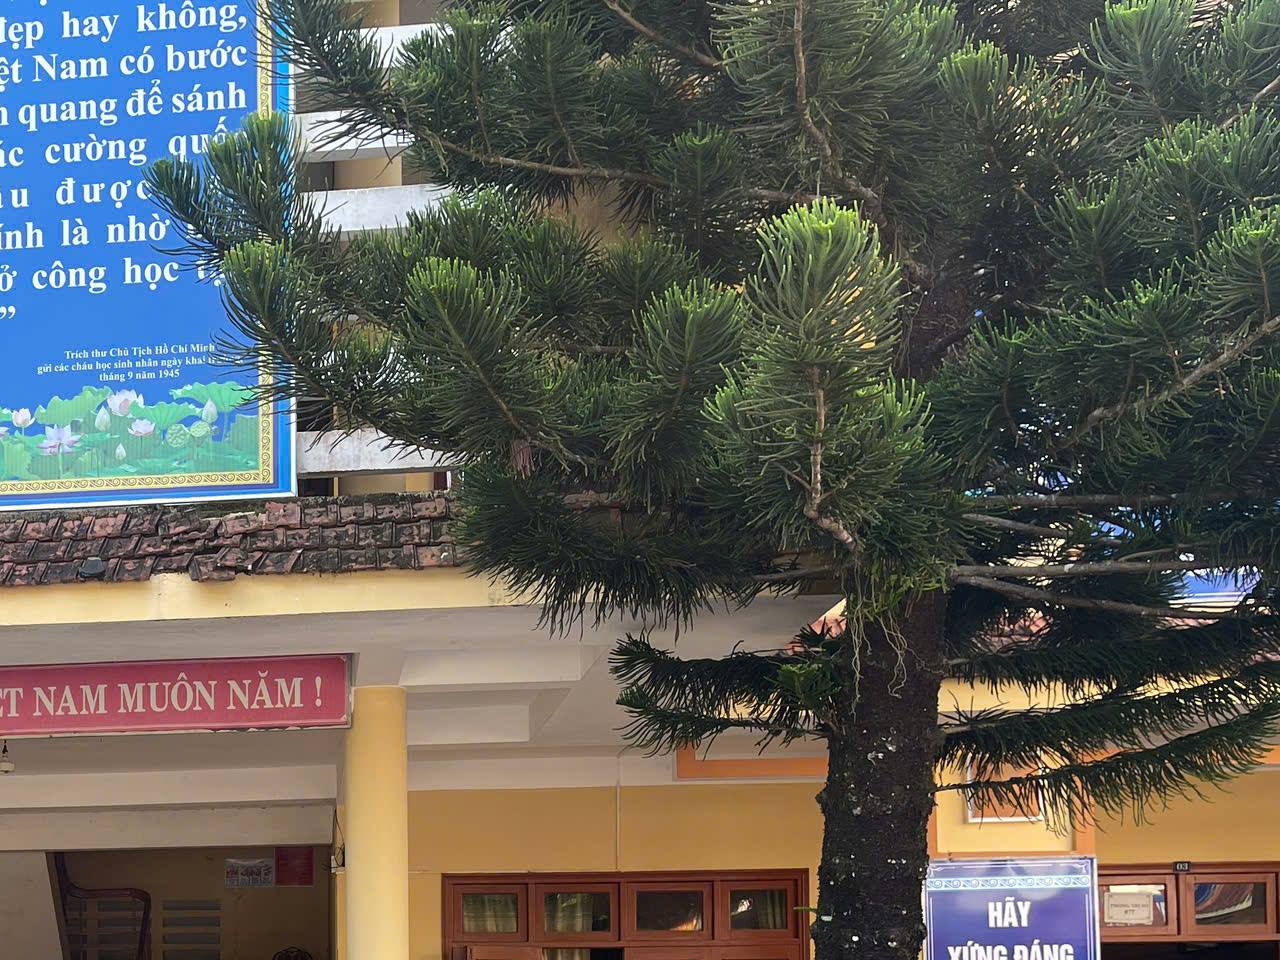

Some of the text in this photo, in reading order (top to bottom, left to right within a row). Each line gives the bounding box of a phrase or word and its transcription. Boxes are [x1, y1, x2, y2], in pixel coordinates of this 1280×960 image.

[62, 11, 119, 43] hay
[137, 0, 247, 33] không,
[32, 53, 108, 82] Nam
[119, 45, 155, 75] có
[166, 39, 247, 72] bước
[18, 98, 118, 132] quang
[126, 79, 163, 117] để
[171, 81, 247, 113] sánh
[45, 133, 147, 166] cường
[61, 218, 90, 246] là
[107, 213, 171, 243] nhờ
[32, 260, 107, 294] công
[123, 257, 179, 291] học
[54, 362, 69, 372] các
[71, 360, 93, 371] cháu
[95, 359, 111, 371] học
[114, 357, 132, 368] sinh
[135, 356, 159, 368] nhân
[161, 357, 183, 368] ngày
[64, 343, 215, 360] Trích thư Chủ Tịch Hồ Chí Minh
[99, 369, 180, 382] tháng 9 năm 1945
[33, 684, 108, 717] NAM
[117, 672, 216, 713] MUÔN
[227, 670, 303, 709] NĂM
[988, 897, 1032, 928] HÃY
